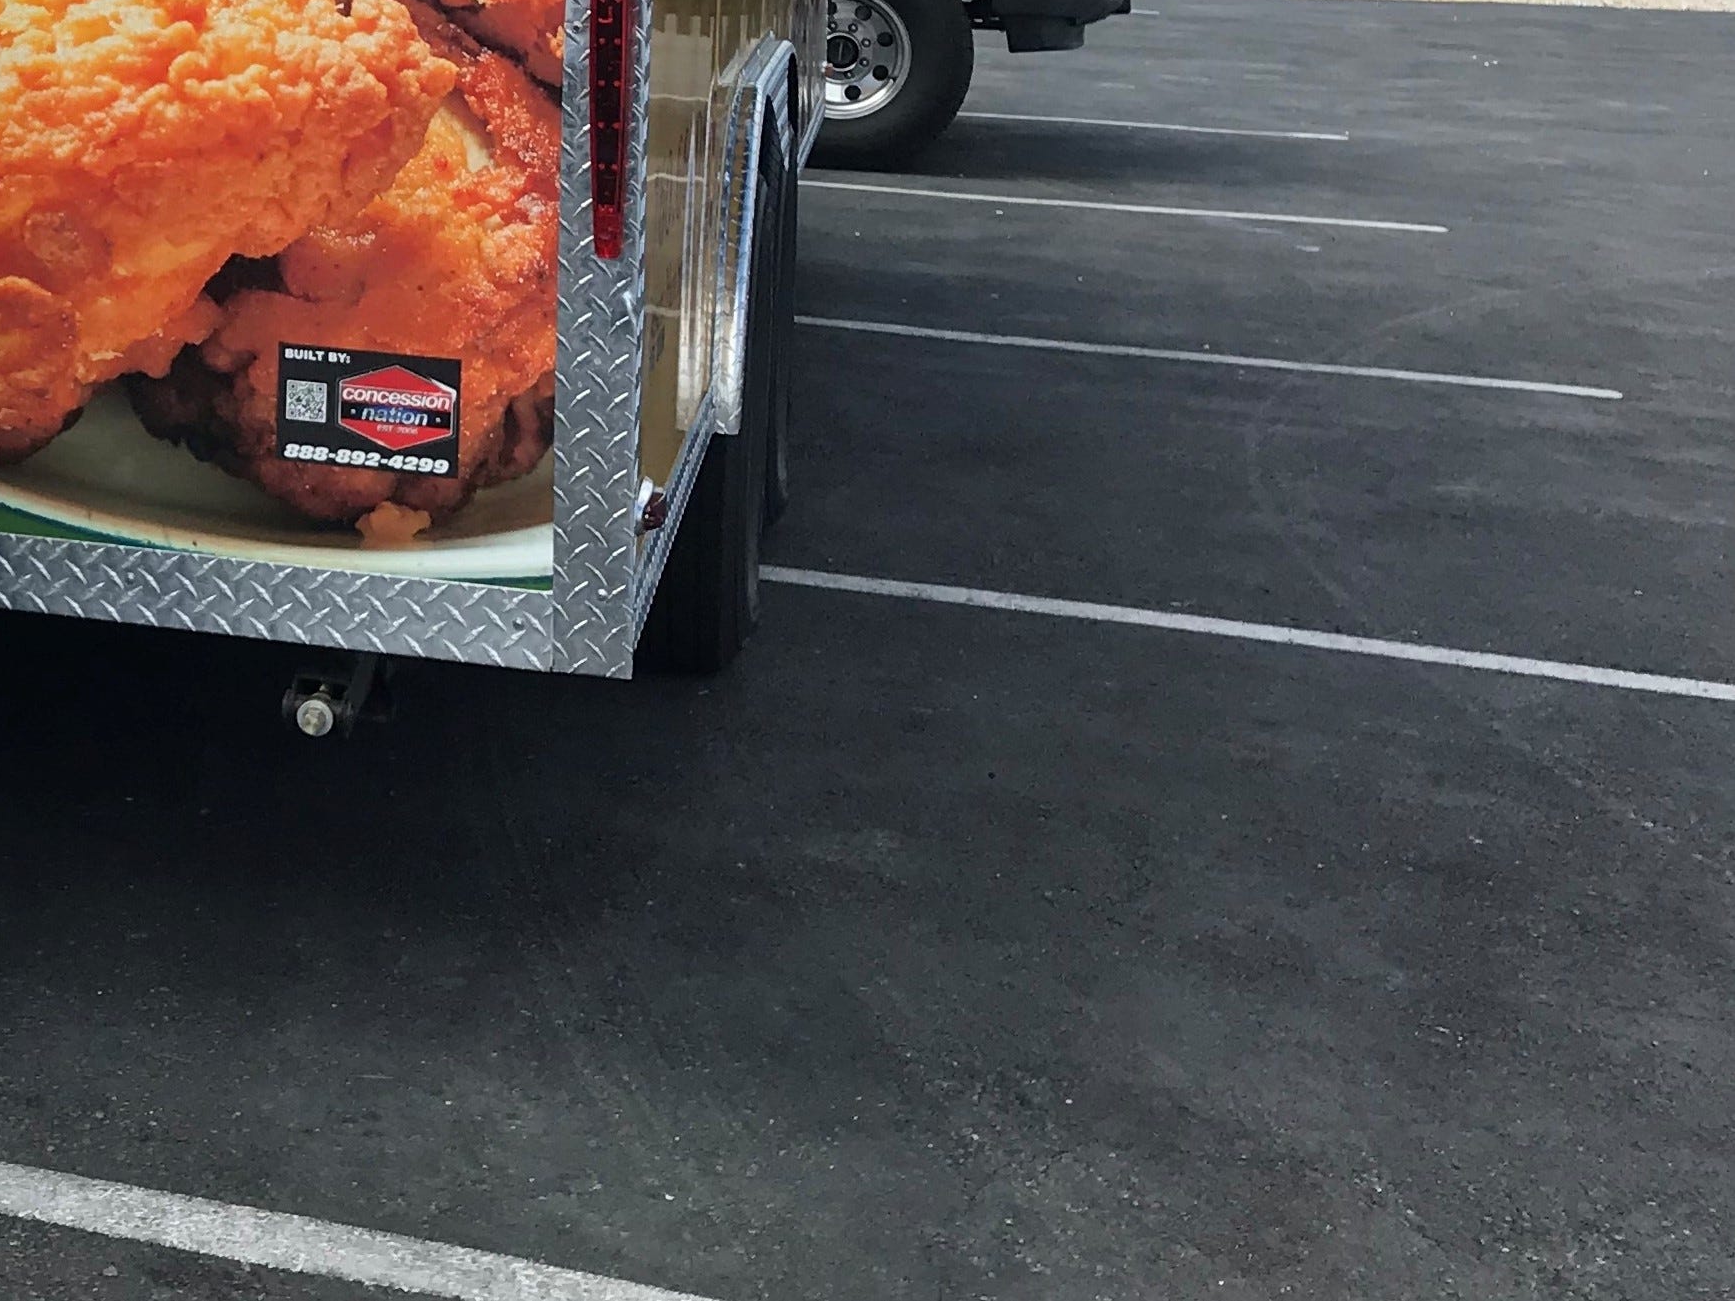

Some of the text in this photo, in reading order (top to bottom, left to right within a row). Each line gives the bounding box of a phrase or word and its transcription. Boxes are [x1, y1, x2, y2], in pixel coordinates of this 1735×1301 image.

[284, 348, 351, 364] BUILT BY:
[342, 387, 451, 411] concession
[361, 405, 429, 426] nation
[283, 443, 450, 475] 888-892-4299
